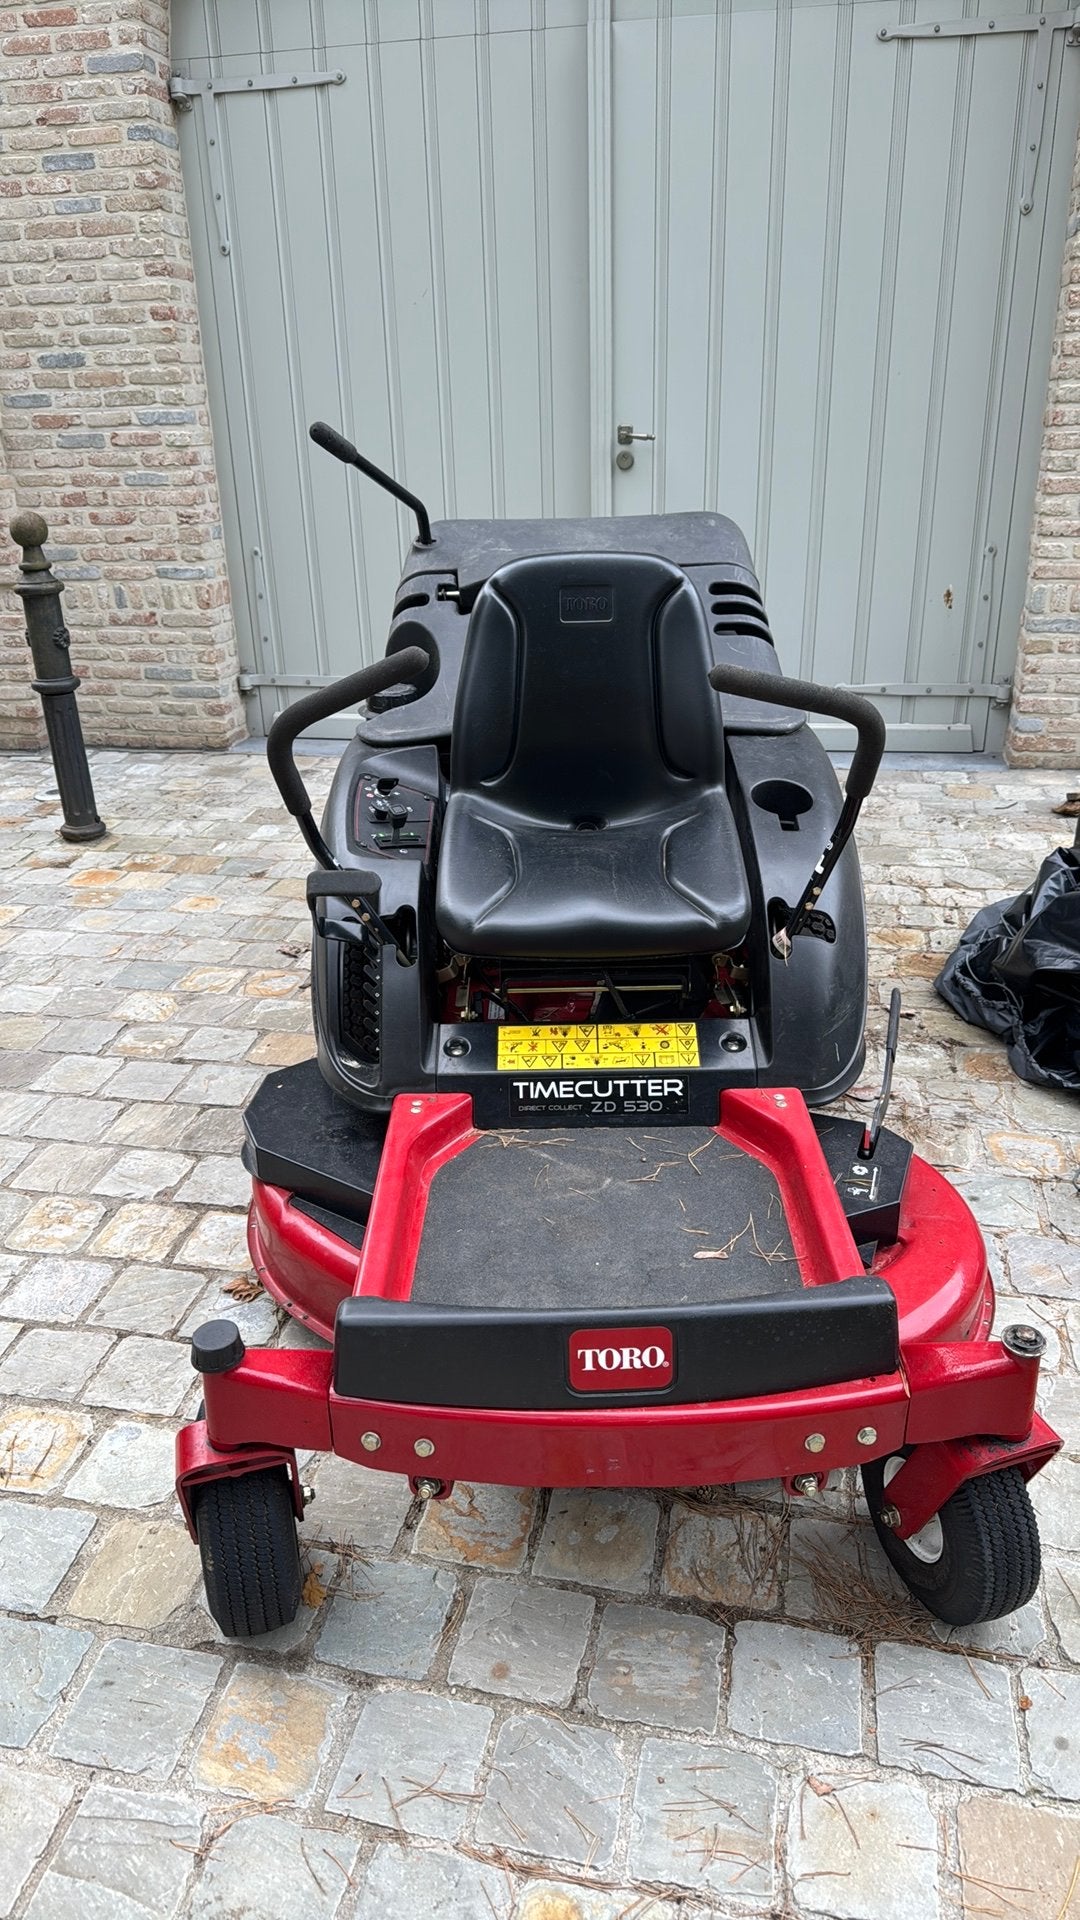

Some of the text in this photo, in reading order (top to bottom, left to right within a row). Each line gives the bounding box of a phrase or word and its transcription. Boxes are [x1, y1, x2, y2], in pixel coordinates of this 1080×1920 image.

[564, 595, 609, 611] TORO
[512, 1079, 684, 1099] TIMECUTTER
[518, 1104, 547, 1112] DIRECT
[591, 1101, 617, 1113] ZD
[624, 1100, 663, 1113] 530
[577, 1345, 666, 1371] TORO
